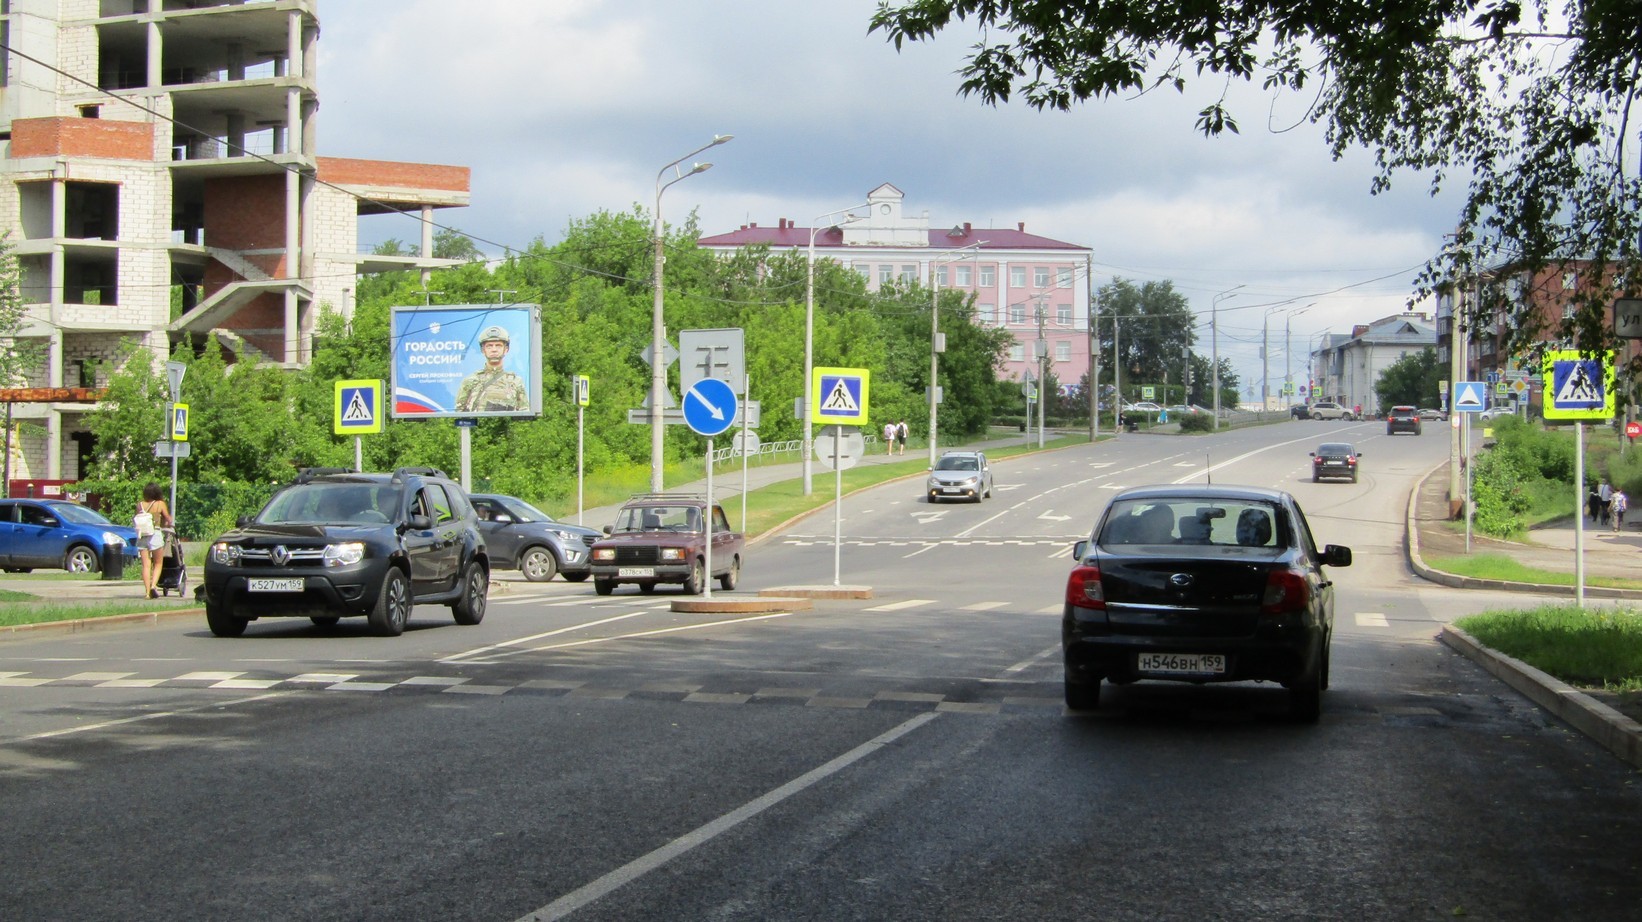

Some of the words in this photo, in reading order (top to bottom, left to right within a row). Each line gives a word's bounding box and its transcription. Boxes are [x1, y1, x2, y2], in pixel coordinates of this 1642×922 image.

[405, 341, 466, 352] ГОРДОСТЬ
[409, 354, 462, 365] РОССИИ!
[251, 580, 287, 590] К527УМ
[288, 579, 302, 588] 159
[1142, 654, 1198, 671] Н546ВН
[1200, 654, 1222, 668] 159
